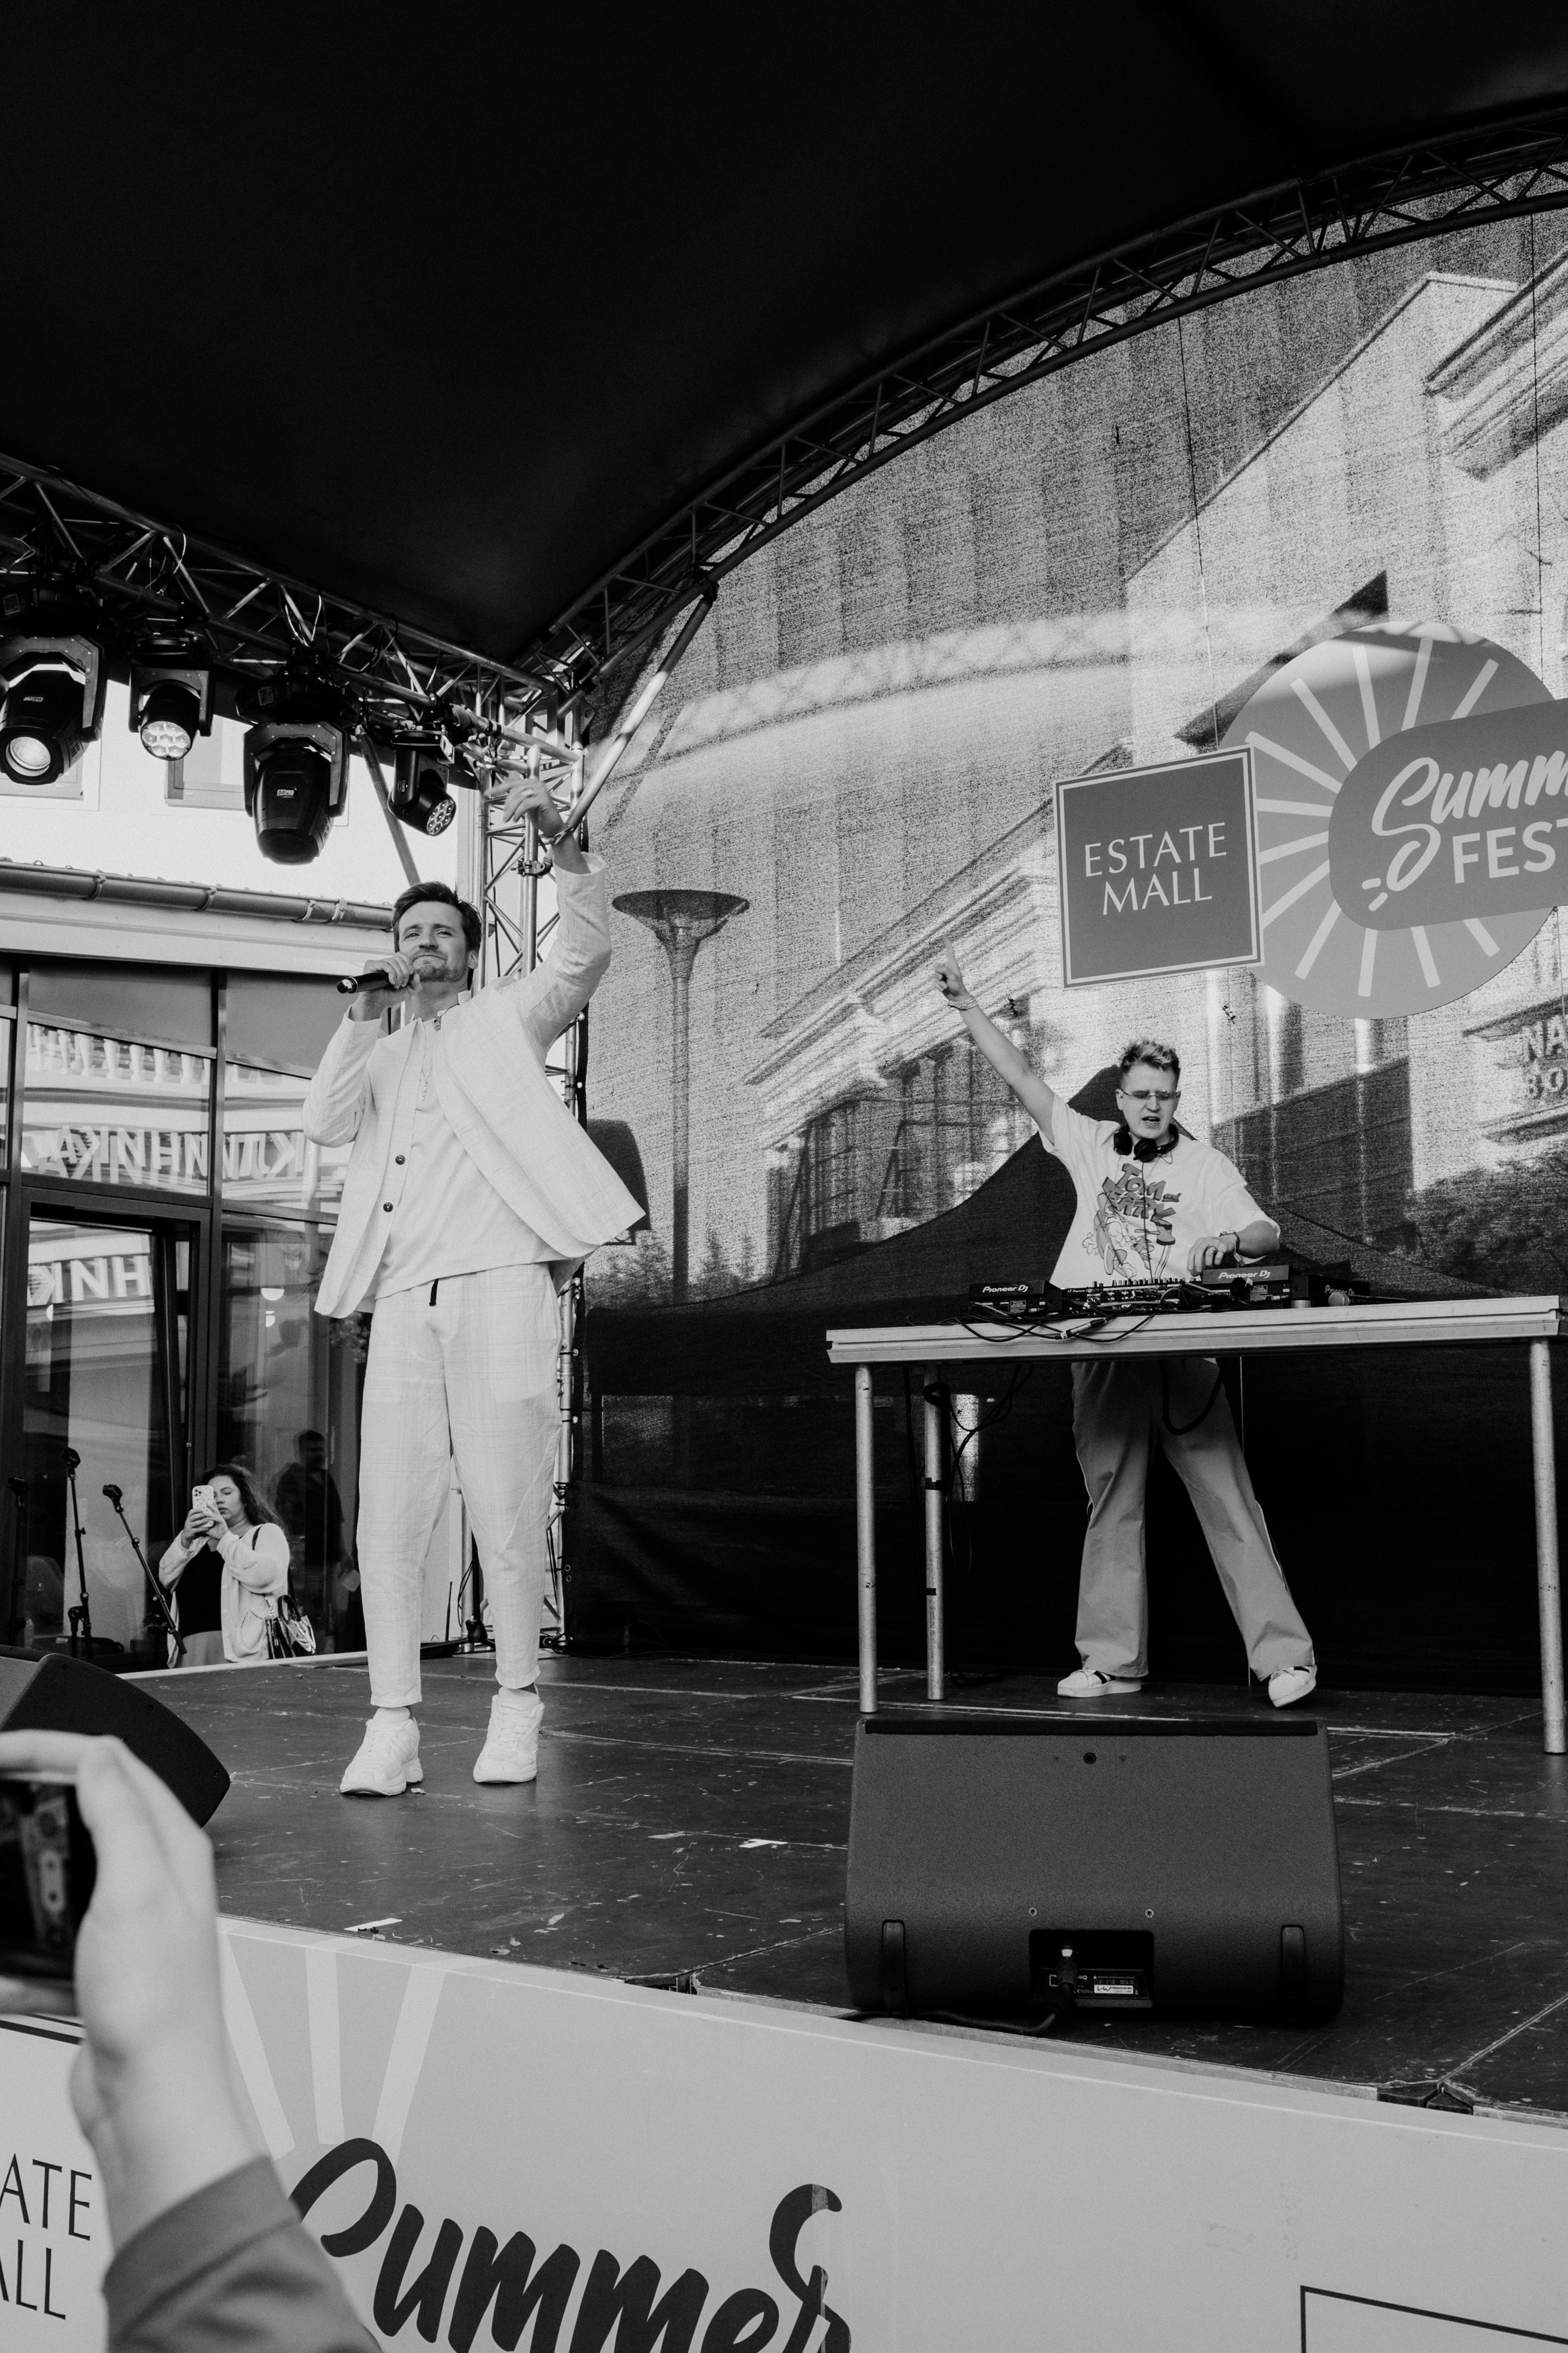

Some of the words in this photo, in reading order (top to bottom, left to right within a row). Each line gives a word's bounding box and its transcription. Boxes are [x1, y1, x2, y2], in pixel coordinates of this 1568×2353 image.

[1085, 822, 1227, 877] ESTATE
[1103, 868, 1212, 915] MALL
[0, 2153, 92, 2241] ATE
